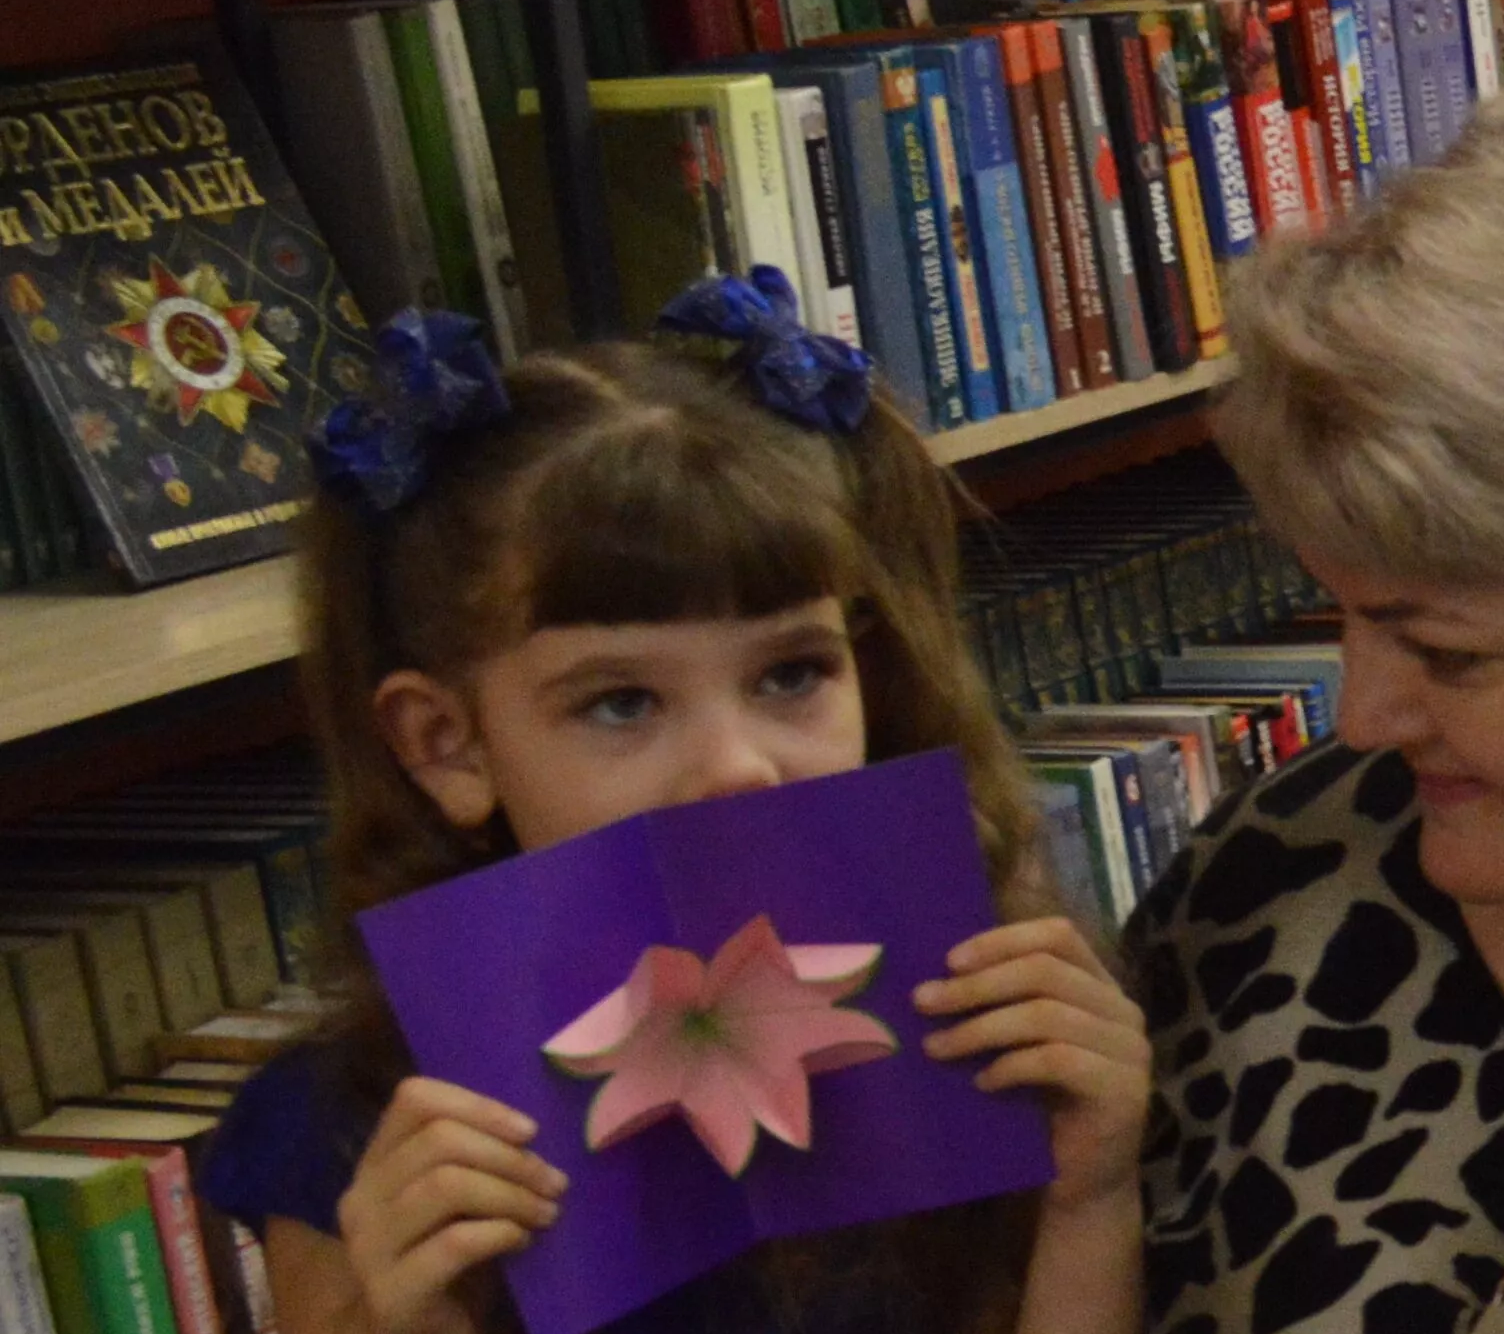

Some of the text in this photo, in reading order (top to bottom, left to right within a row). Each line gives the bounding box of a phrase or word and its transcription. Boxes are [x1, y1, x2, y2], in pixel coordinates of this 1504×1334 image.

[0, 89, 229, 183] РДЕНОВ
[1321, 74, 1350, 170] ИСТОРИЯ
[20, 146, 267, 241] МЕДАЛЕЙ
[914, 208, 960, 387] ЭНЦИКЛОПЕДИЯ
